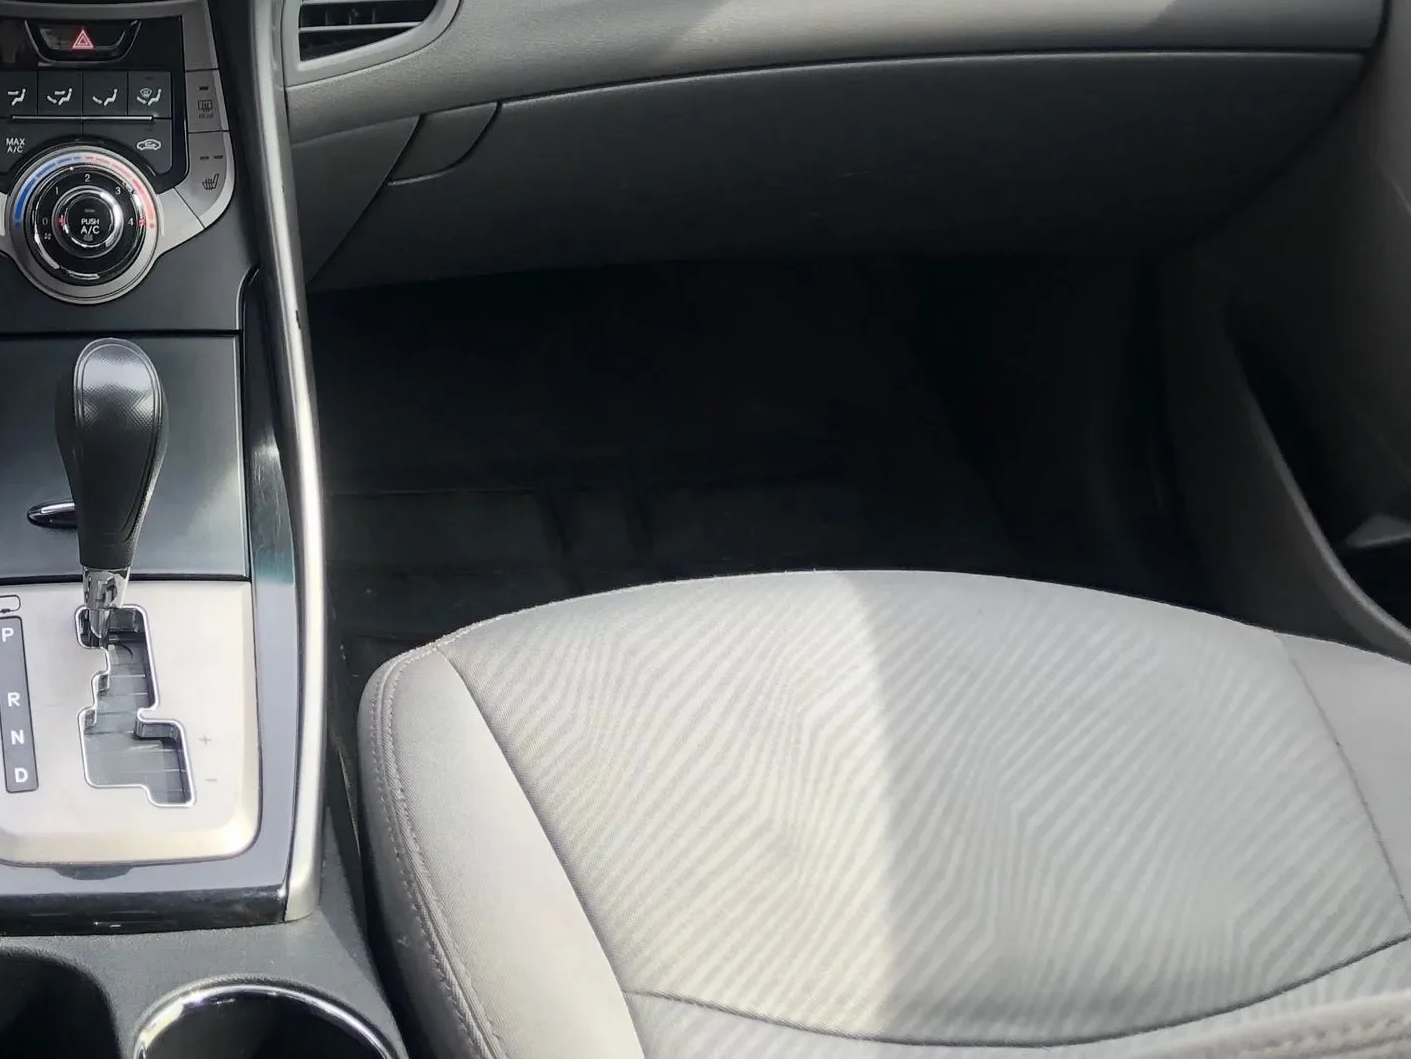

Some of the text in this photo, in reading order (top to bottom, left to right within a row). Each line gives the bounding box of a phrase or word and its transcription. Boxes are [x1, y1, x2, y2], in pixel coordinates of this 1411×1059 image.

[6, 137, 26, 146] MAX
[7, 145, 24, 154] A/C
[84, 174, 91, 183] 2
[115, 187, 122, 195] 3
[42, 218, 48, 226] 0
[128, 217, 134, 226] 4
[80, 226, 100, 234] A/C
[1, 627, 14, 642] P
[7, 693, 21, 707] R
[11, 729, 24, 745] N
[14, 767, 29, 783] D
